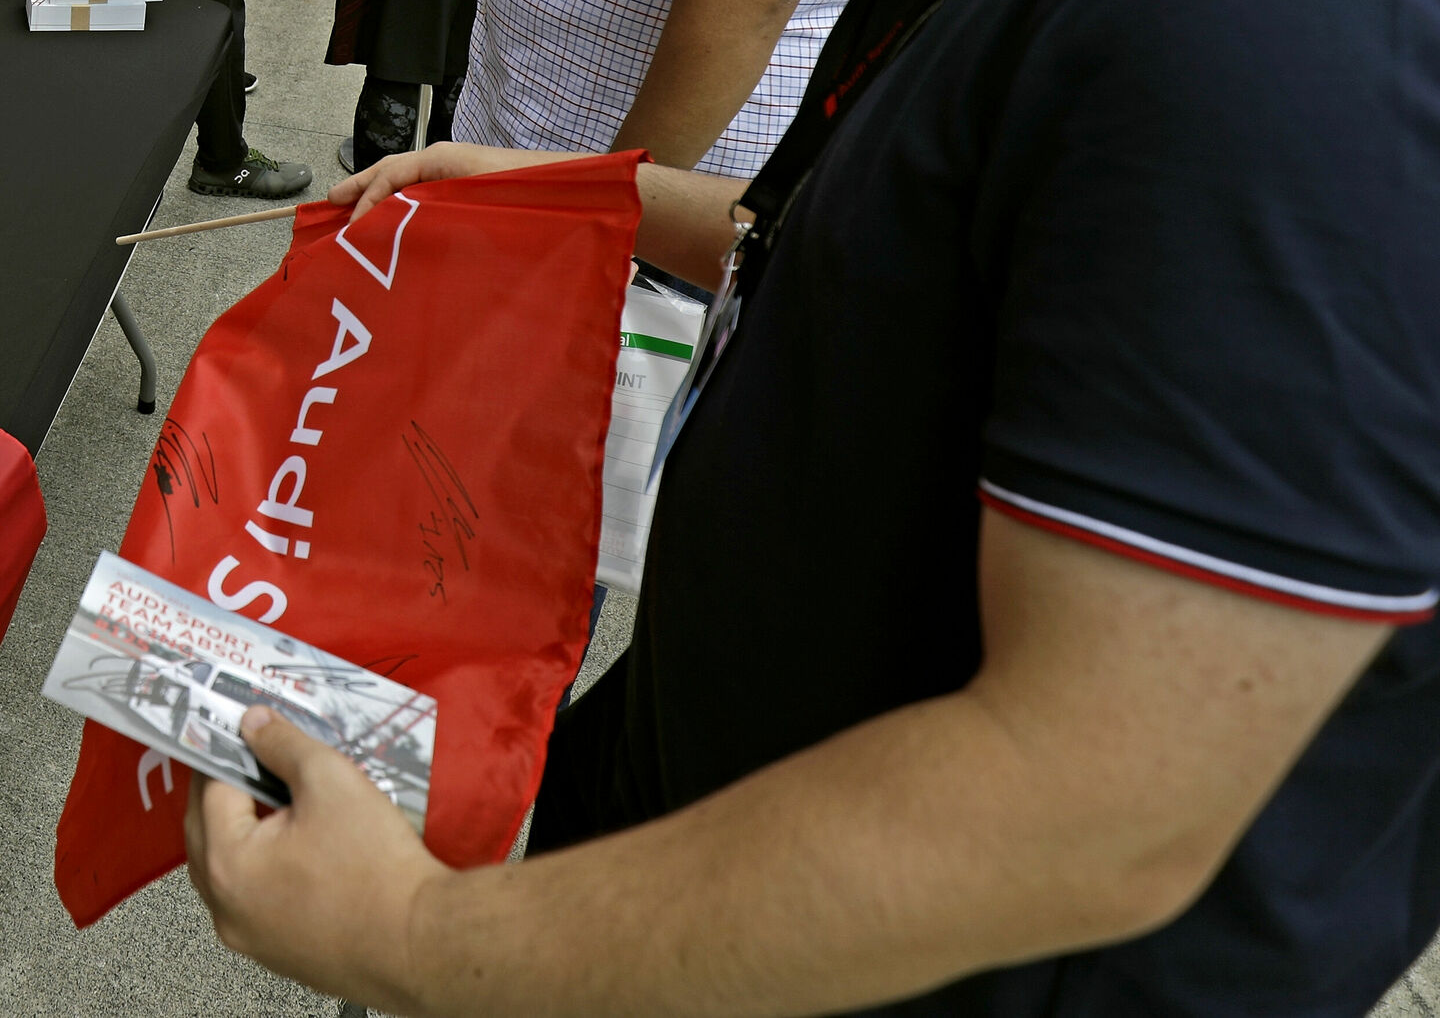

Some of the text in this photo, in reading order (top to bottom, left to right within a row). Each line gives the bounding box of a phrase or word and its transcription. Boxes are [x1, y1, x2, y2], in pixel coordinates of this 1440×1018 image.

[244, 296, 375, 561] Audi
[92, 618, 152, 653] #125
[99, 604, 195, 658] RACING
[106, 593, 174, 633] TEAM
[180, 630, 310, 694] ABSOLUTE
[109, 580, 169, 615] AUDI
[174, 610, 255, 654] SPORT
